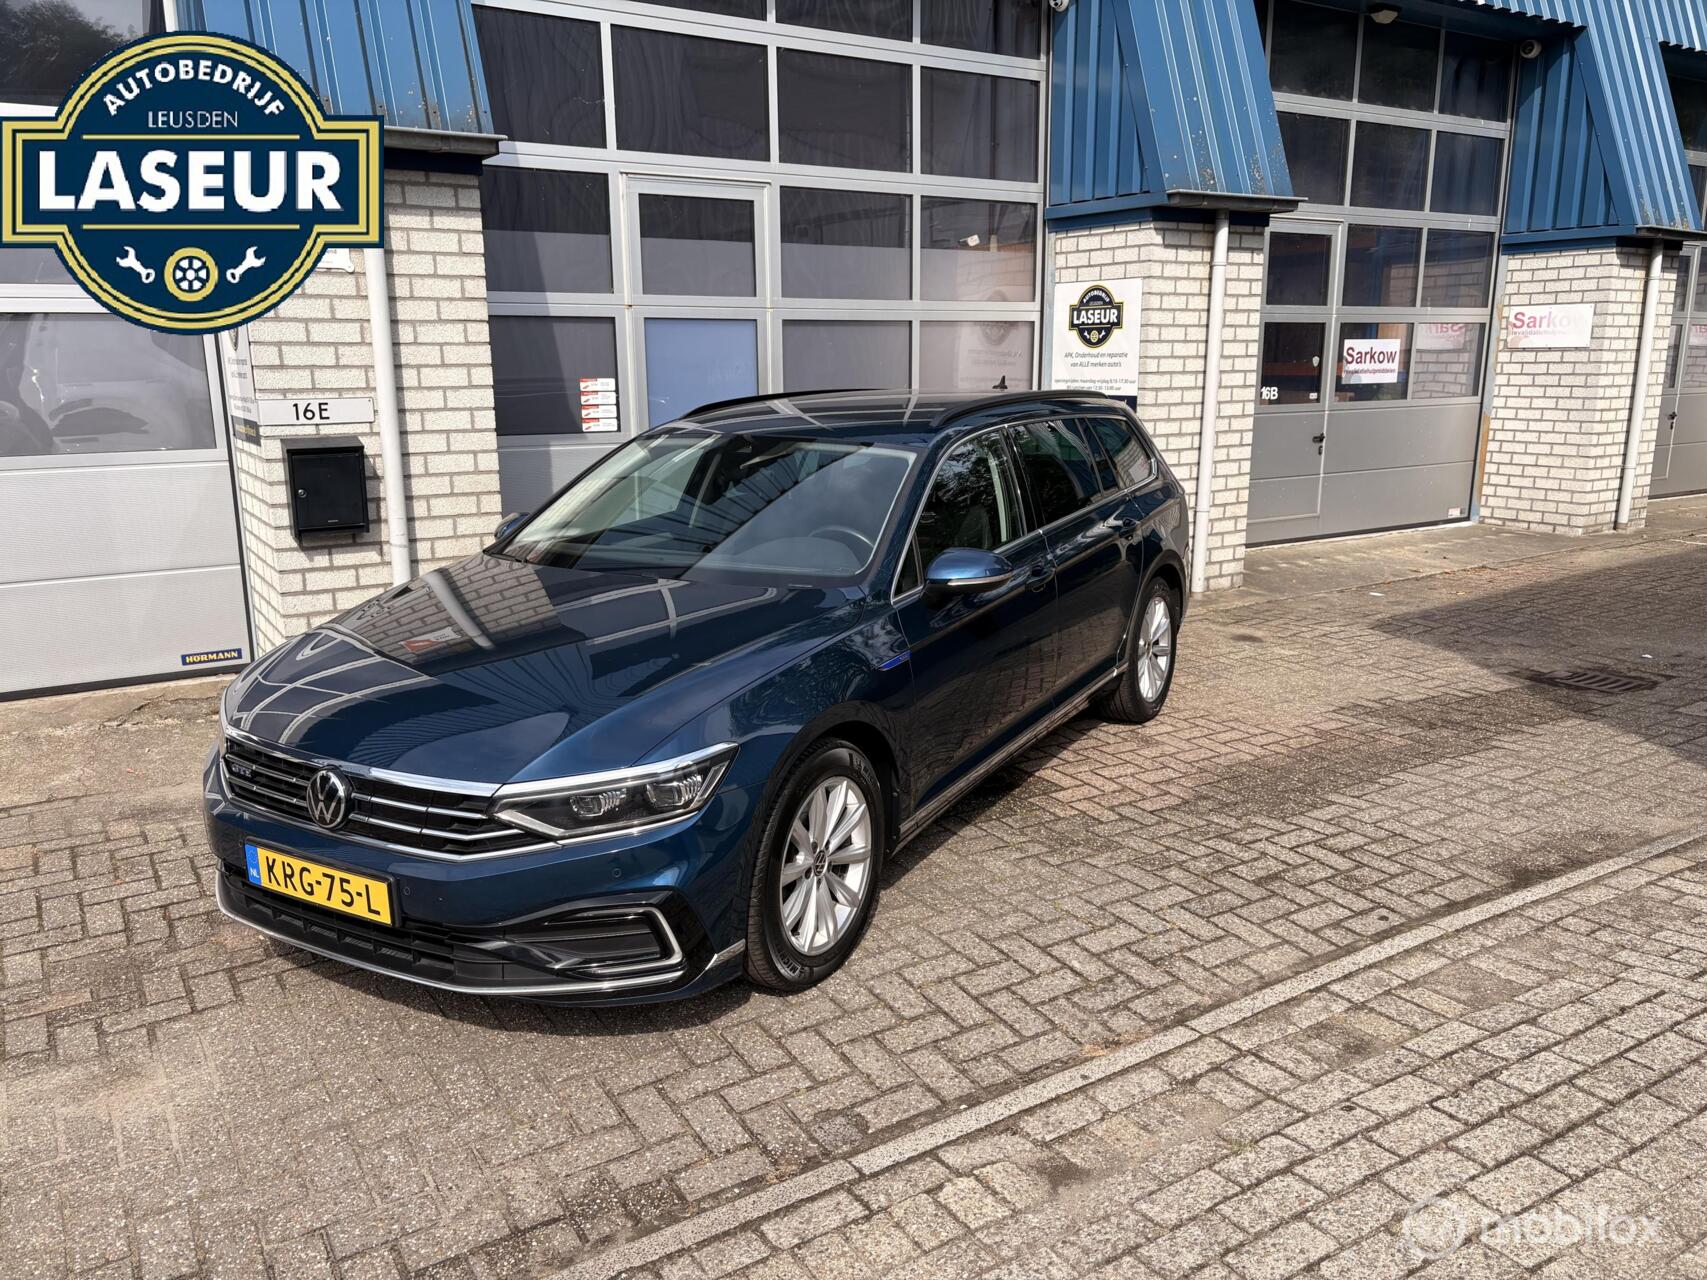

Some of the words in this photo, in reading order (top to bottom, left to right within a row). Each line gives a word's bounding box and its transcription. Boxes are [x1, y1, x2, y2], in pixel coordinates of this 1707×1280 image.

[1073, 309, 1118, 324] LASEUR
[1345, 346, 1397, 365] Sarkow
[1261, 386, 1278, 400] 16B
[292, 403, 330, 421] 16E
[250, 868, 260, 878] NL
[265, 856, 381, 916] KRG-75-L
